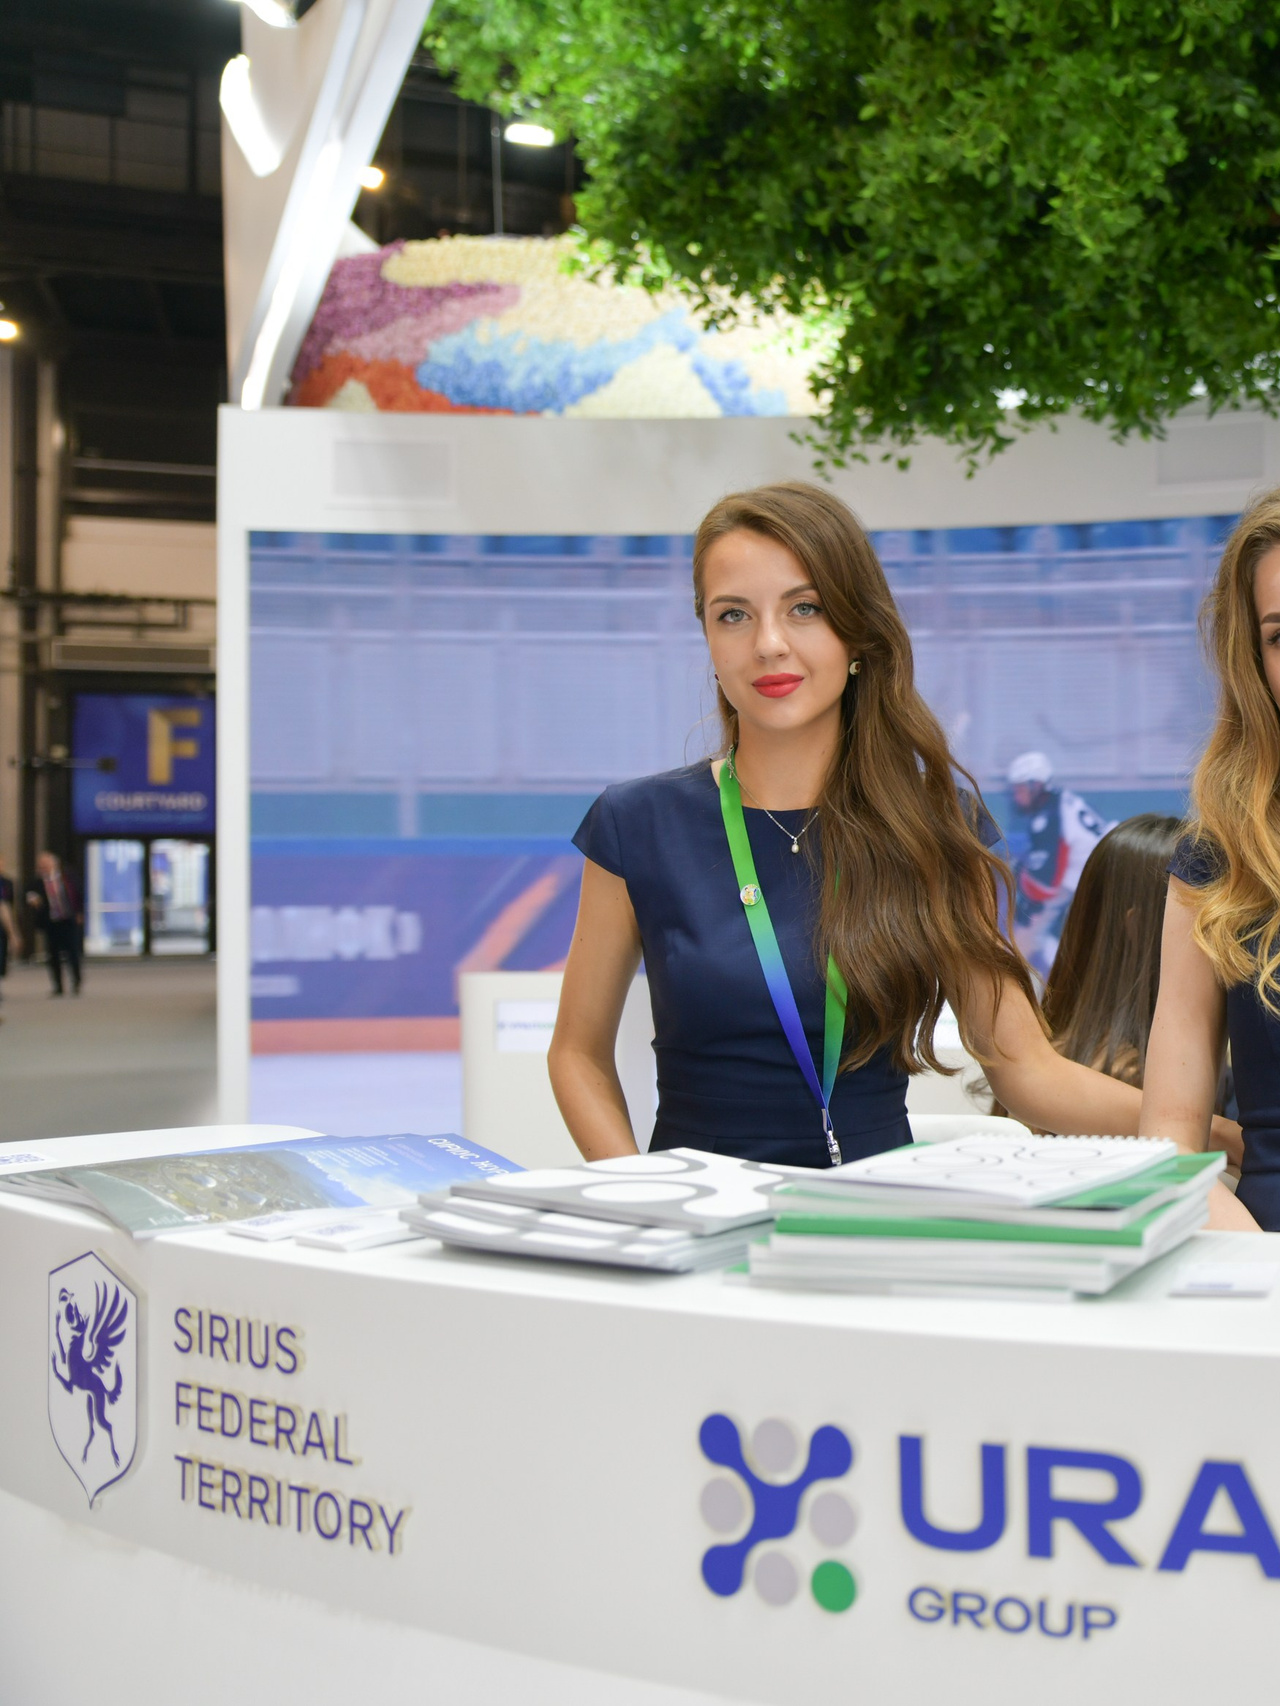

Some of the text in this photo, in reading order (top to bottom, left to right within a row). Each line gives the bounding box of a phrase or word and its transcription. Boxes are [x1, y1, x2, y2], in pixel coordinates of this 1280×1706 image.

[148, 707, 201, 786] F
[173, 1305, 302, 1376] SIRIUS
[174, 1380, 358, 1466] FEDERAL
[173, 1455, 407, 1556] TERRITORY
[906, 1585, 1119, 1641] GROUP
